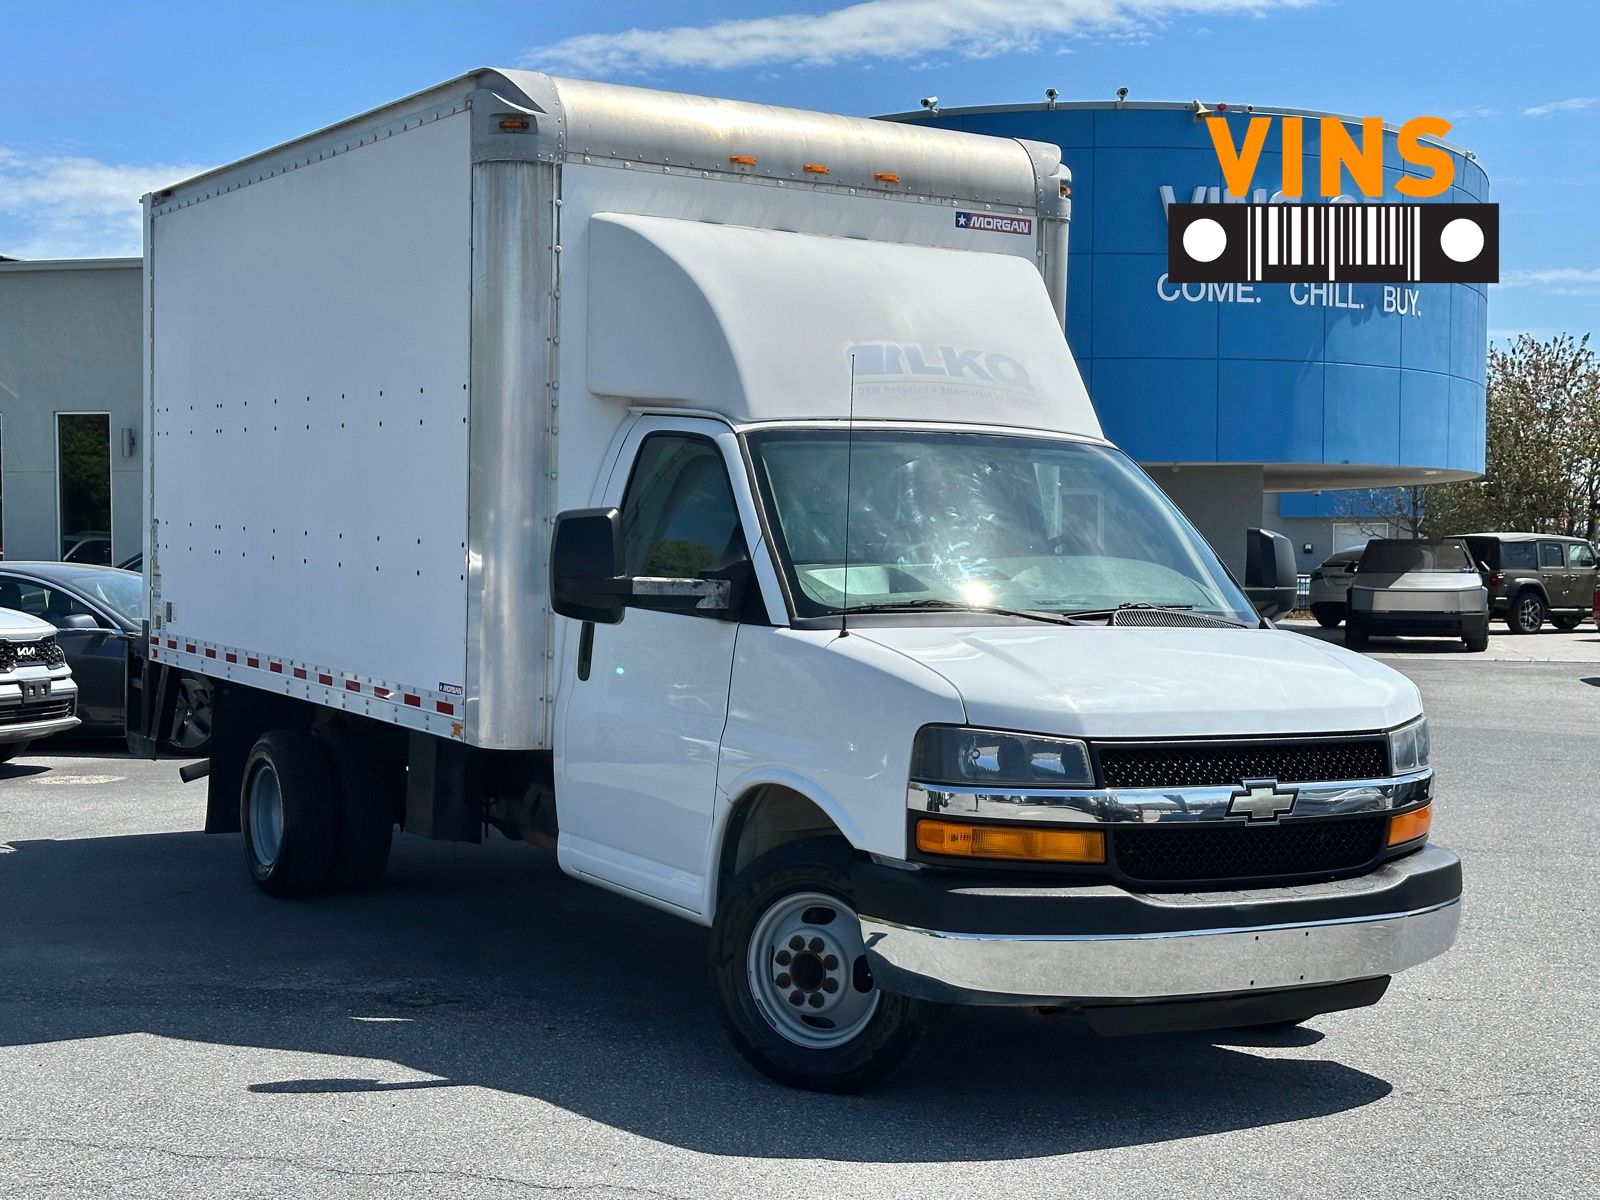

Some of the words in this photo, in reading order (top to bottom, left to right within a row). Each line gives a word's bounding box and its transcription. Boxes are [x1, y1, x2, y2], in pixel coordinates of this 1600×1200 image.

[970, 216, 1029, 233] MORGAN
[1157, 273, 1262, 304] COME.
[1290, 281, 1364, 310] CHILL.
[1383, 285, 1422, 317] BUY.
[903, 343, 1037, 393] LKQ
[884, 386, 929, 397] Recycled
[442, 684, 463, 695] MORGAN
